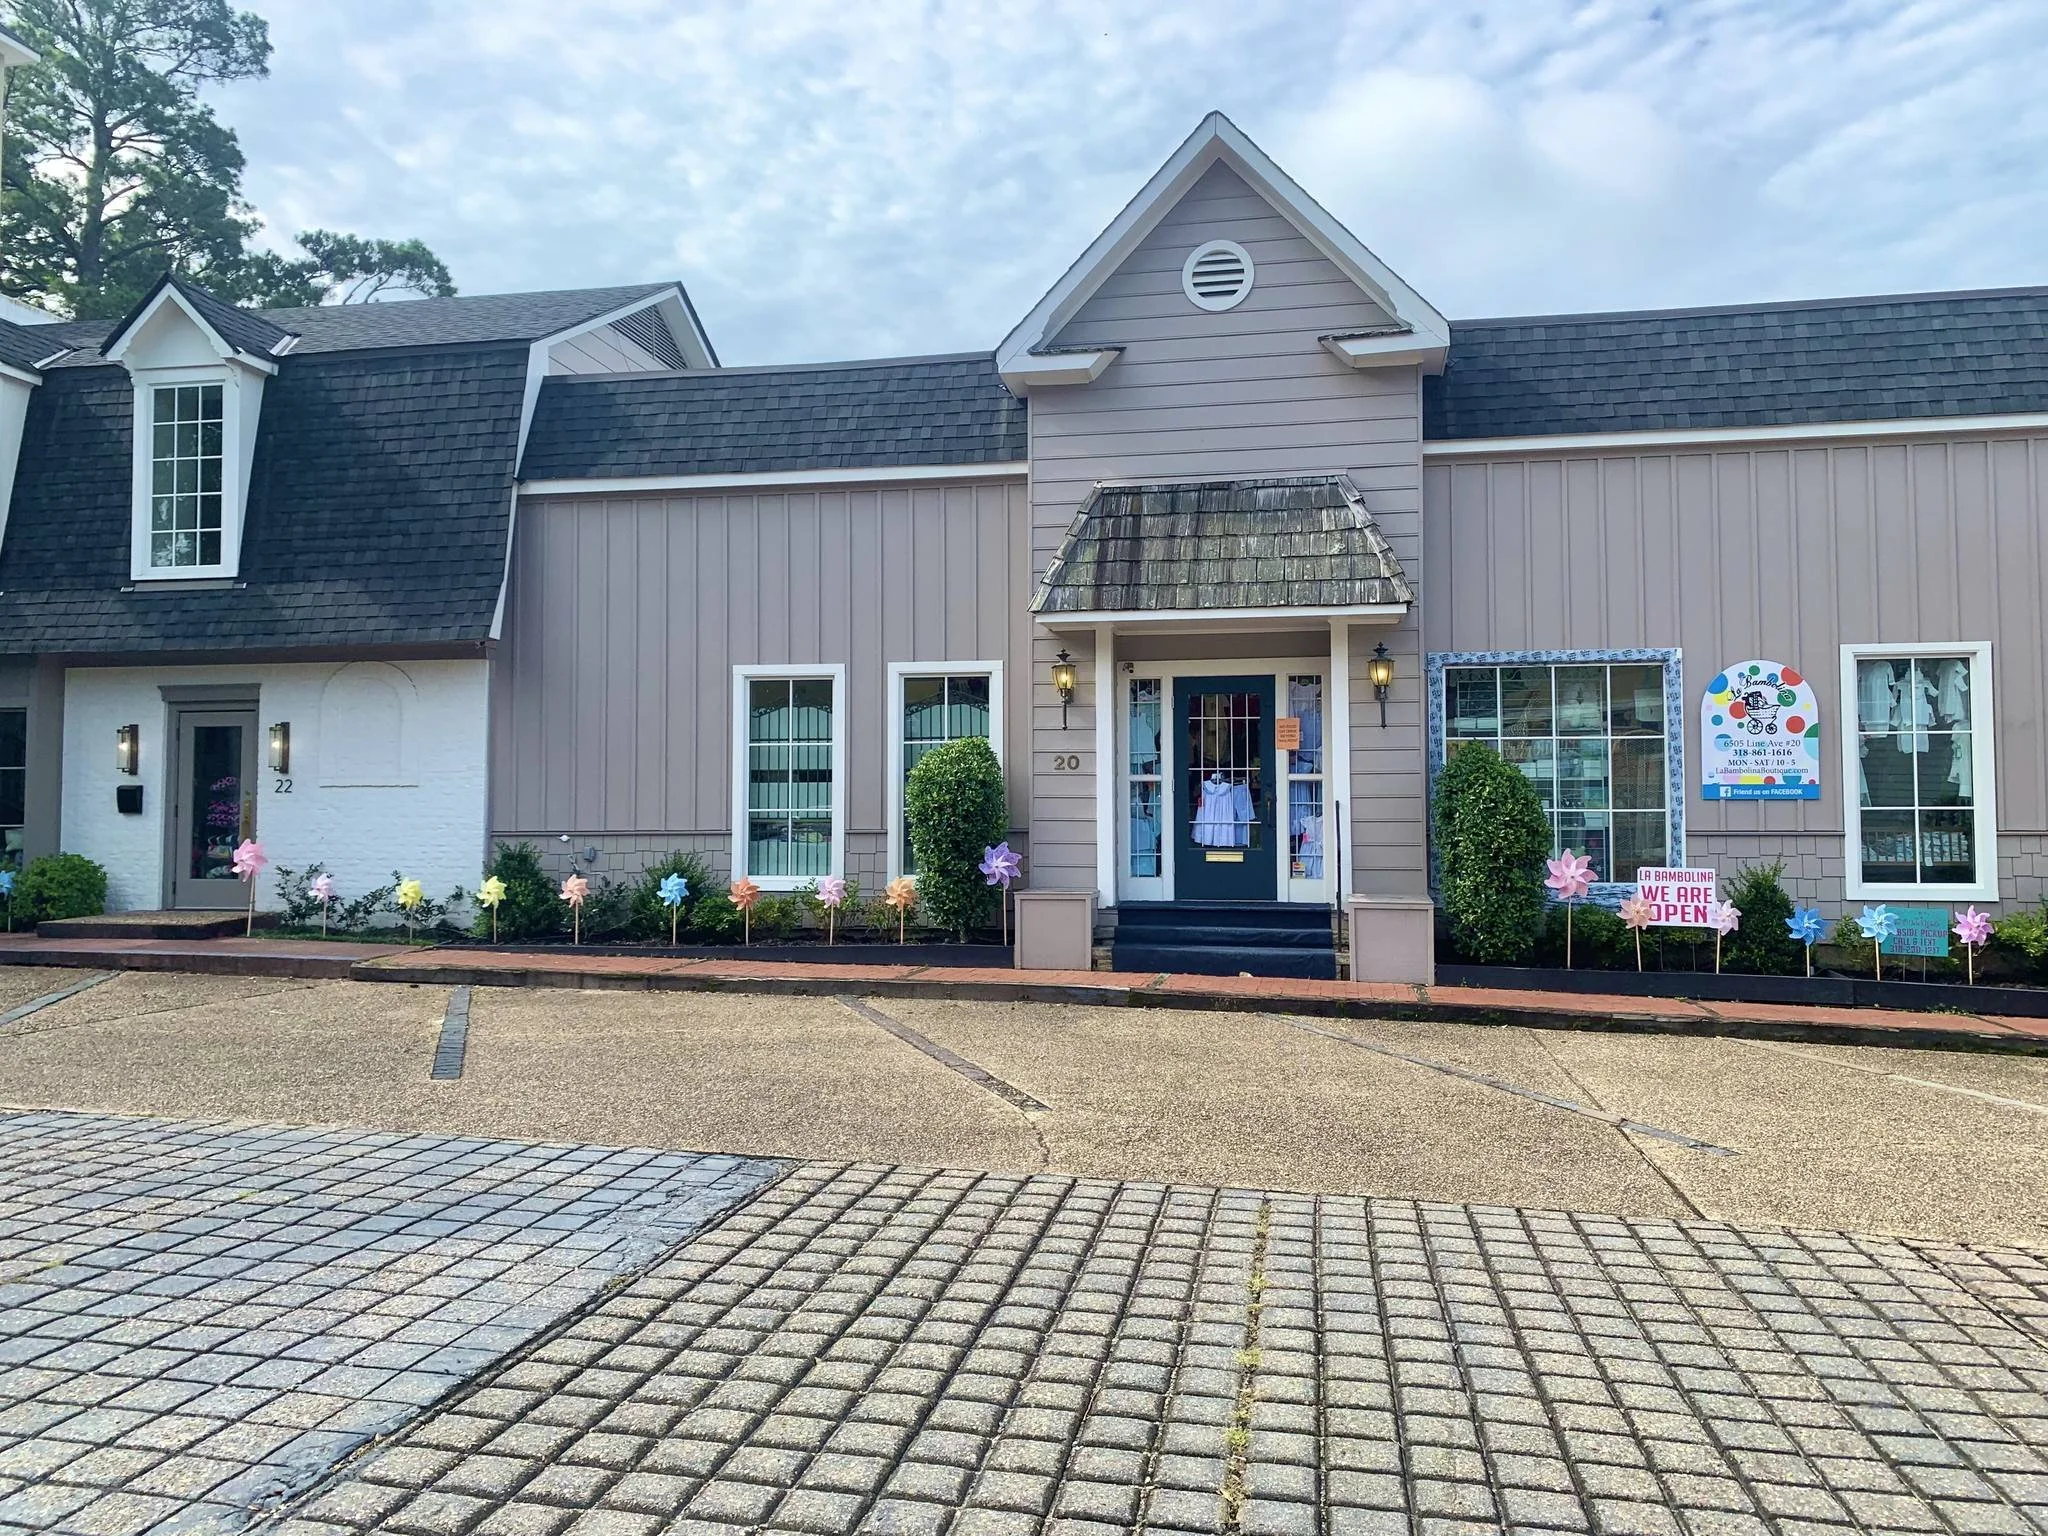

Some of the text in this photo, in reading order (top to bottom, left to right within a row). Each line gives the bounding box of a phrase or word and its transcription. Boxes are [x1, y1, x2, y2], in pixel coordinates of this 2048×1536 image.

[1727, 675, 1793, 702] La Bambolina
[1746, 740, 1766, 748] Line
[1732, 749, 1793, 757] 318-861-1616
[1054, 755, 1080, 770] 20
[1754, 759, 1769, 767] SAT
[1715, 767, 1809, 775] LaBambolinaBoutique.com
[275, 779, 293, 793] 22
[1639, 870, 1714, 883] LA BAMBOLINA
[1641, 885, 1713, 904] WE ARE
[1920, 929, 1948, 938] PICKUP
